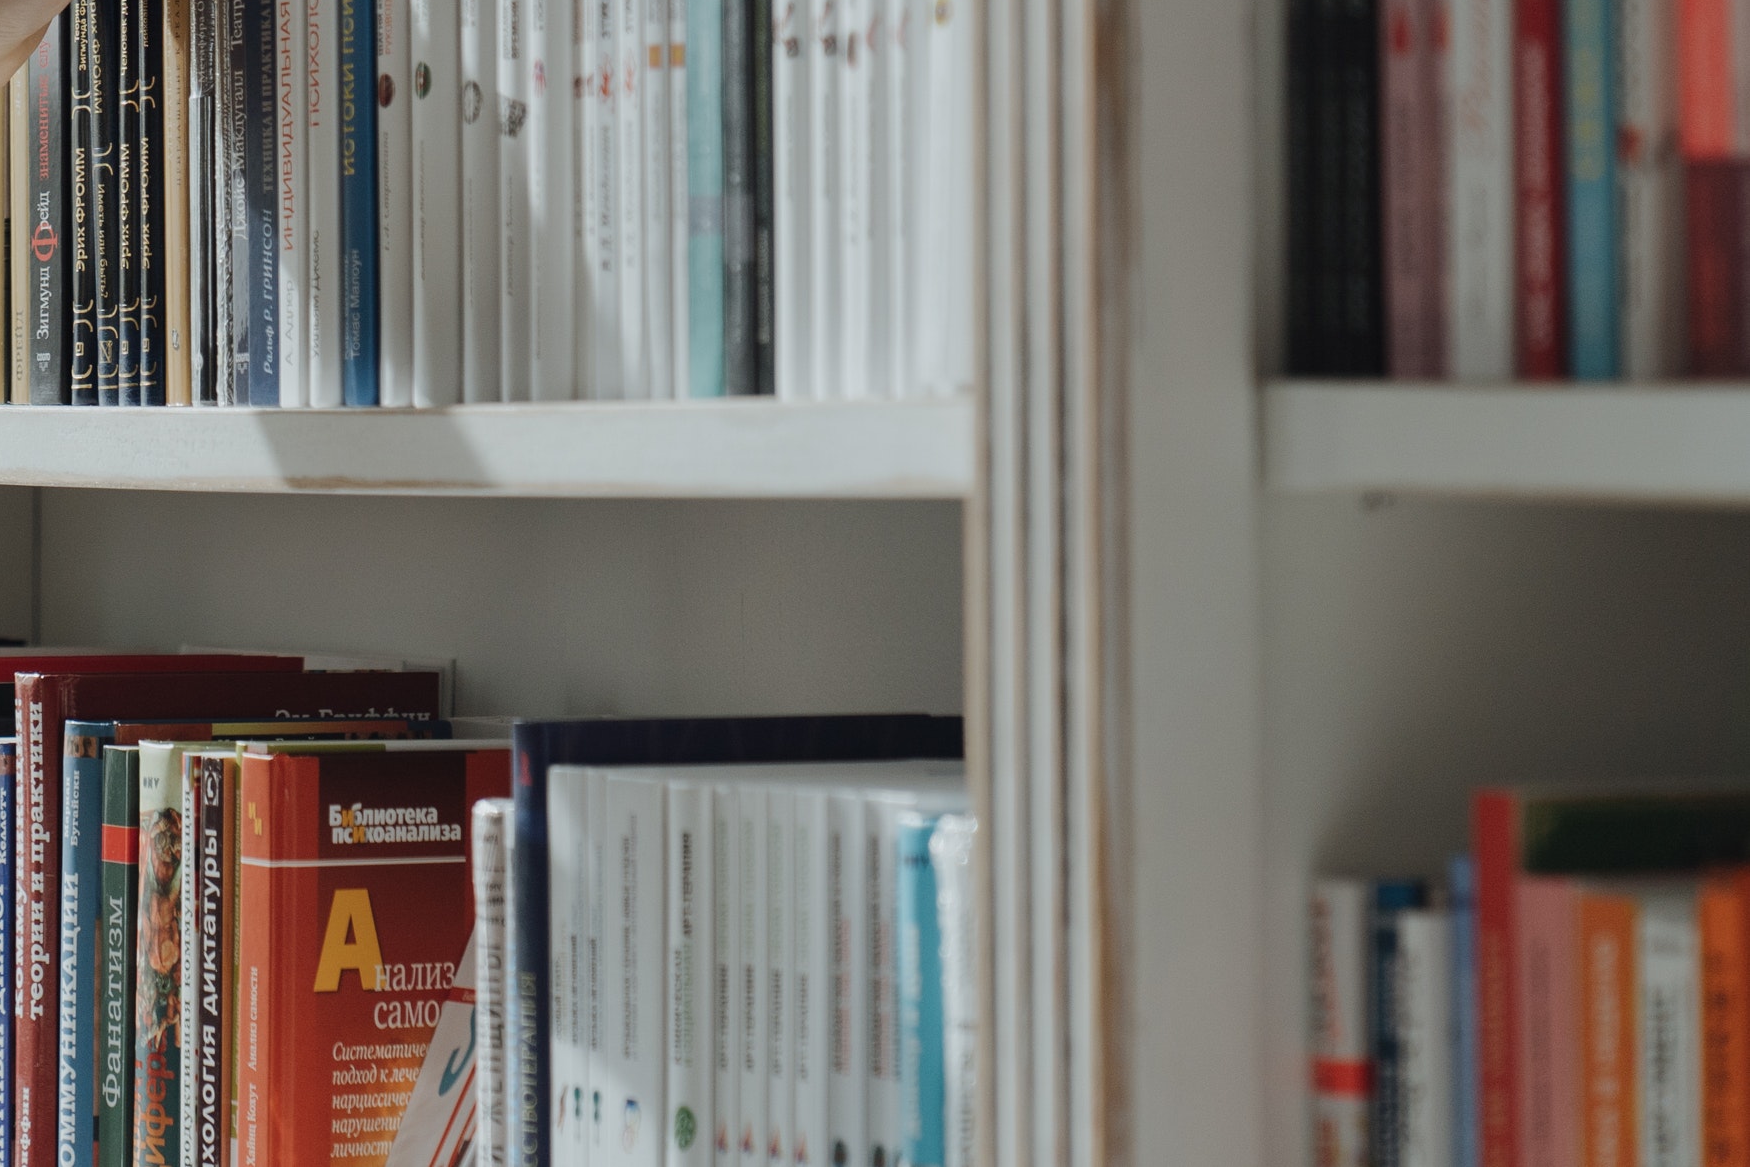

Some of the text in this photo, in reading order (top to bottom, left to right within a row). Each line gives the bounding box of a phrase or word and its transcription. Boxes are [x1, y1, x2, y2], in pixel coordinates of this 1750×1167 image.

[38, 41, 50, 69] слу
[73, 3, 82, 43] Теория
[79, 18, 89, 71] Зигмунда
[119, 17, 128, 77] Человек
[197, 15, 207, 83] Метафора
[260, 9, 273, 98] ПРАКТИКА
[511, 0, 520, 60] ВРЕМЕНИ
[91, 38, 103, 114] ФРОММ
[261, 100, 273, 112] И
[38, 74, 50, 180] знаменитые
[232, 69, 248, 171] Макдугалл
[261, 115, 274, 194] ТЕХНИКА
[279, 0, 295, 251] ИНДИВИДУАЛЬНАЯ
[342, 63, 355, 176] ИСТОКИ
[30, 190, 58, 262] Фрейд
[74, 147, 88, 272] Эрих ФРОММ
[97, 184, 109, 299] Иметь или быть?
[119, 143, 132, 270] Эрих ФРОММ
[140, 137, 152, 269] Эрих ФРОММ
[232, 177, 248, 240] Джойс
[262, 209, 275, 375] Ральф Р. ГРИНСОН
[311, 229, 321, 292] Джемс
[35, 266, 52, 340] Зигмунд
[284, 279, 295, 367] А. Адлер
[350, 312, 361, 360] Томас
[14, 309, 25, 382] ФРЕЙД
[70, 769, 81, 847] Бугайски
[328, 802, 438, 827] Библиотека
[332, 823, 462, 844] психоанализа
[28, 701, 51, 1021] теории и практики
[202, 828, 221, 1017] диктатуры
[313, 888, 456, 993] Анализ
[101, 894, 123, 1109] Фанатизм
[182, 789, 194, 1167] родуктивная коммуникация
[373, 999, 443, 1030] само
[59, 870, 81, 1167] ОММУНИКАЦИИ
[139, 1030, 175, 1167] ифера
[246, 965, 260, 1166] Хайнц Кохут Анализ самости
[331, 1090, 413, 1115] нарциссичес
[332, 1063, 378, 1085] подход
[380, 1065, 388, 1082] к
[519, 970, 538, 1167] ССТВОТЕРАПИЯ
